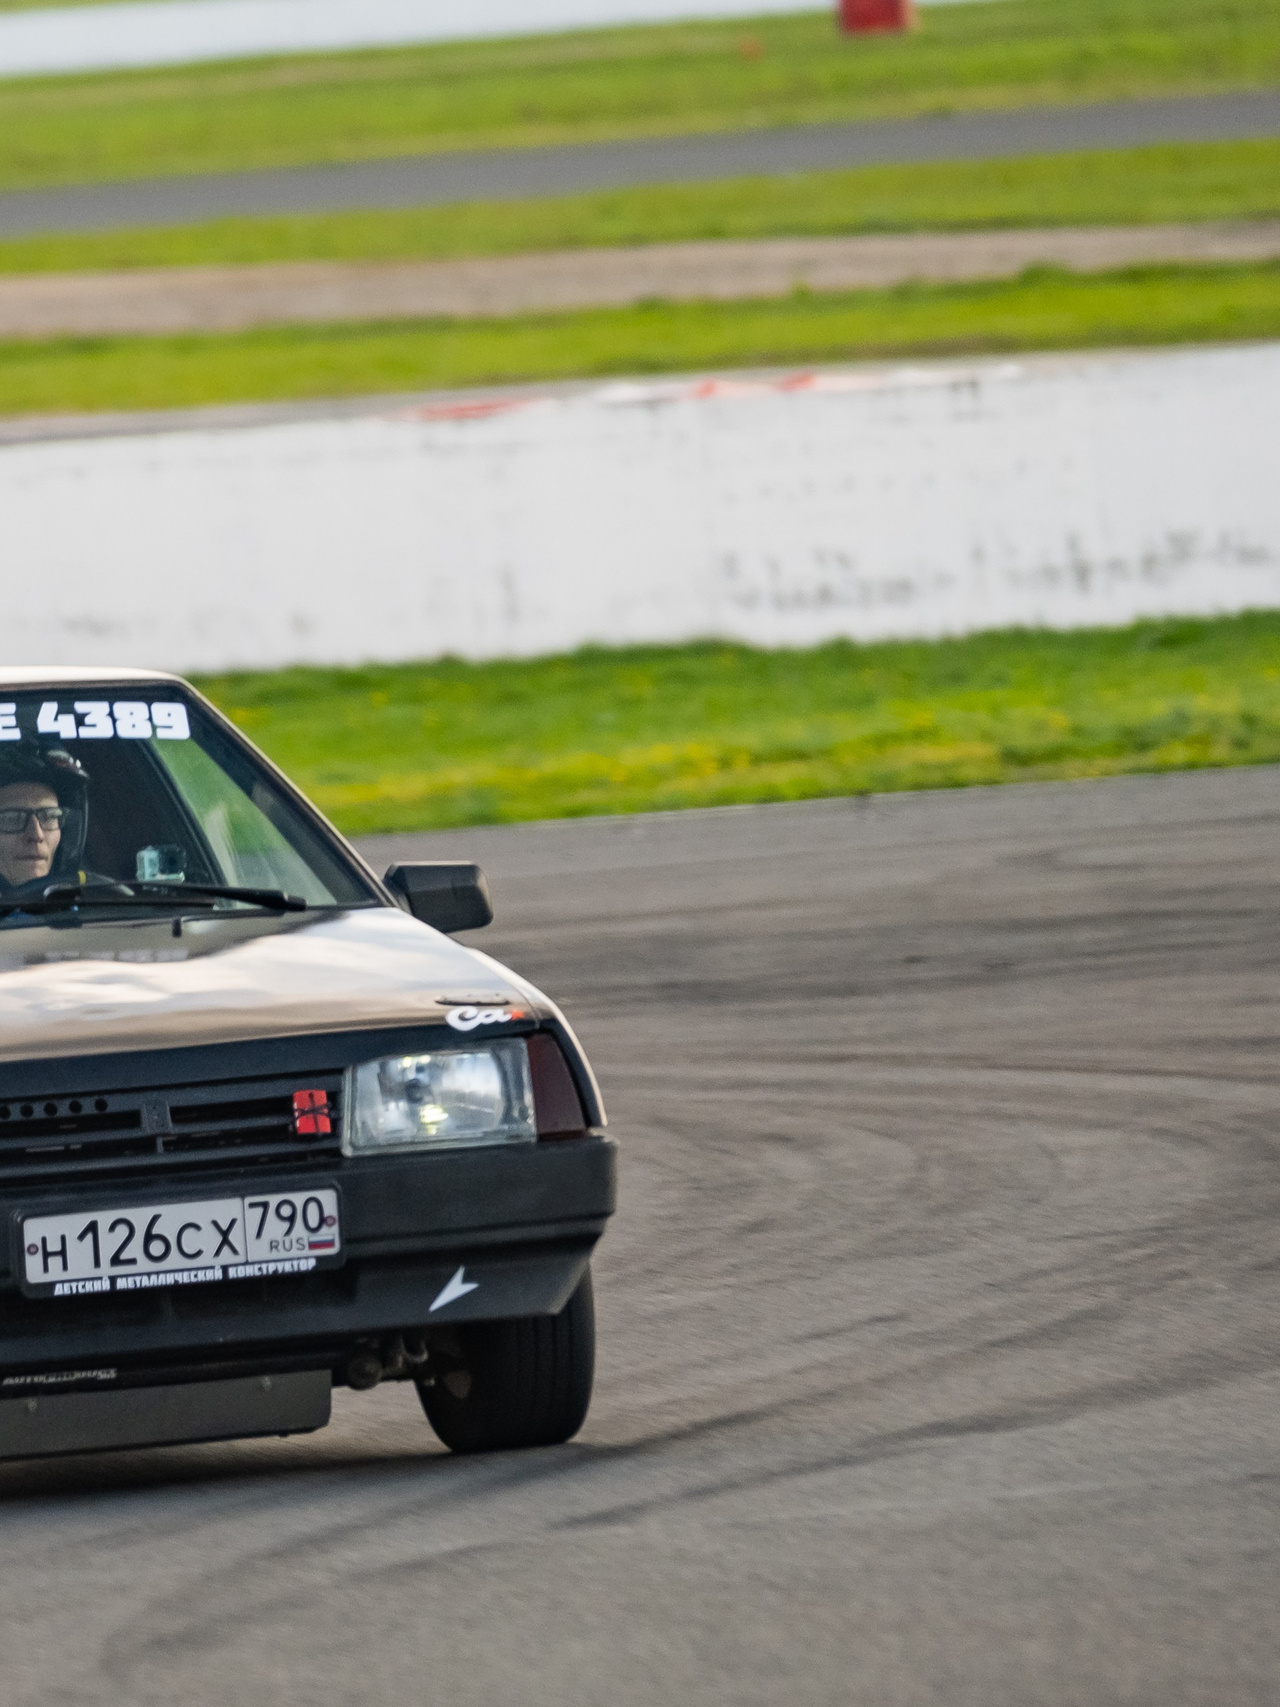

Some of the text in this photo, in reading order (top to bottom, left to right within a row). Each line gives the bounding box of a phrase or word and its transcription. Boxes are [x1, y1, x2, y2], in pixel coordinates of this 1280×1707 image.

[36, 701, 191, 740] 4389
[248, 1196, 325, 1240] 790
[270, 1238, 306, 1253] RUS
[53, 1257, 317, 1296] ДЕТСКИЙ МЕТАЛЛИЧЕСКИЙ КОНСТРУКТОР
